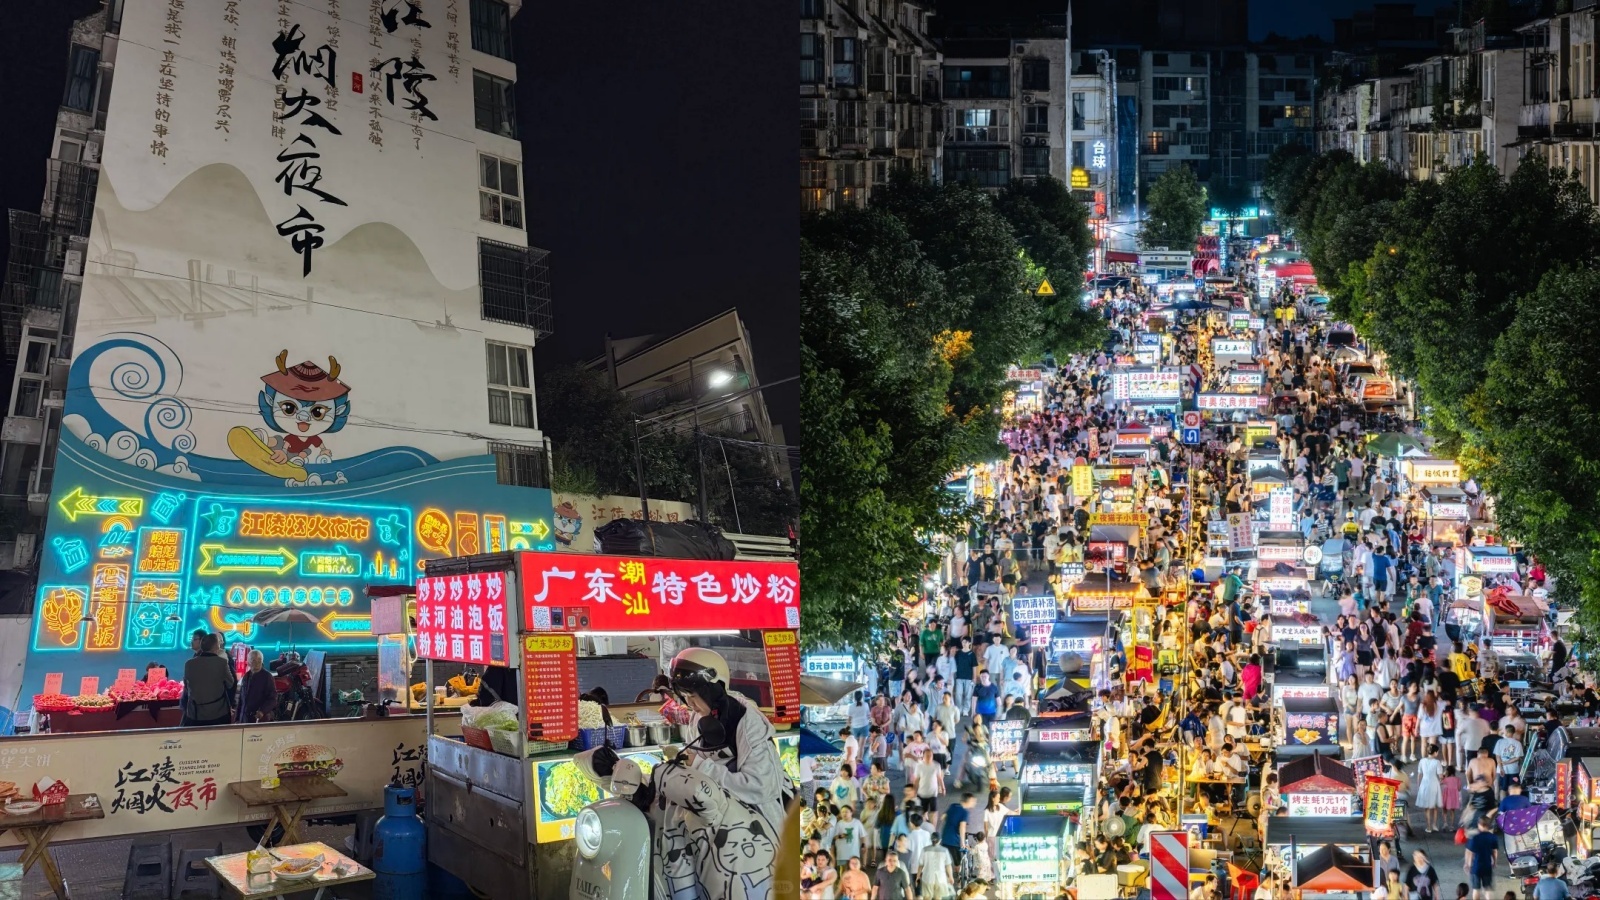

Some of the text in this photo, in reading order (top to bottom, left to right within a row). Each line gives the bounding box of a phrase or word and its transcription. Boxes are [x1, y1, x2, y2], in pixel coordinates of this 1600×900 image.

[1093, 141, 1107, 169] 台球
[1199, 396, 1257, 408] 新奥尔良烤翅
[1100, 513, 1147, 522] 夜猫子小黄鱼
[241, 511, 370, 540] 江陵烟火夜市
[99, 530, 134, 547] LOVE
[140, 559, 180, 572] 小龙虾
[1014, 598, 1055, 609] 椰奶清补凉
[1014, 609, 1055, 620] 8元自助冰粉
[1031, 624, 1052, 634] 柠檬水
[1031, 637, 1048, 645] 柠檬
[809, 661, 853, 671] 8元自助冰粉
[114, 755, 181, 788] 江陵
[1292, 795, 1349, 805] 烤生蚝1元1个
[1314, 806, 1348, 815] 10个起烤
[576, 877, 601, 898] TAILG
